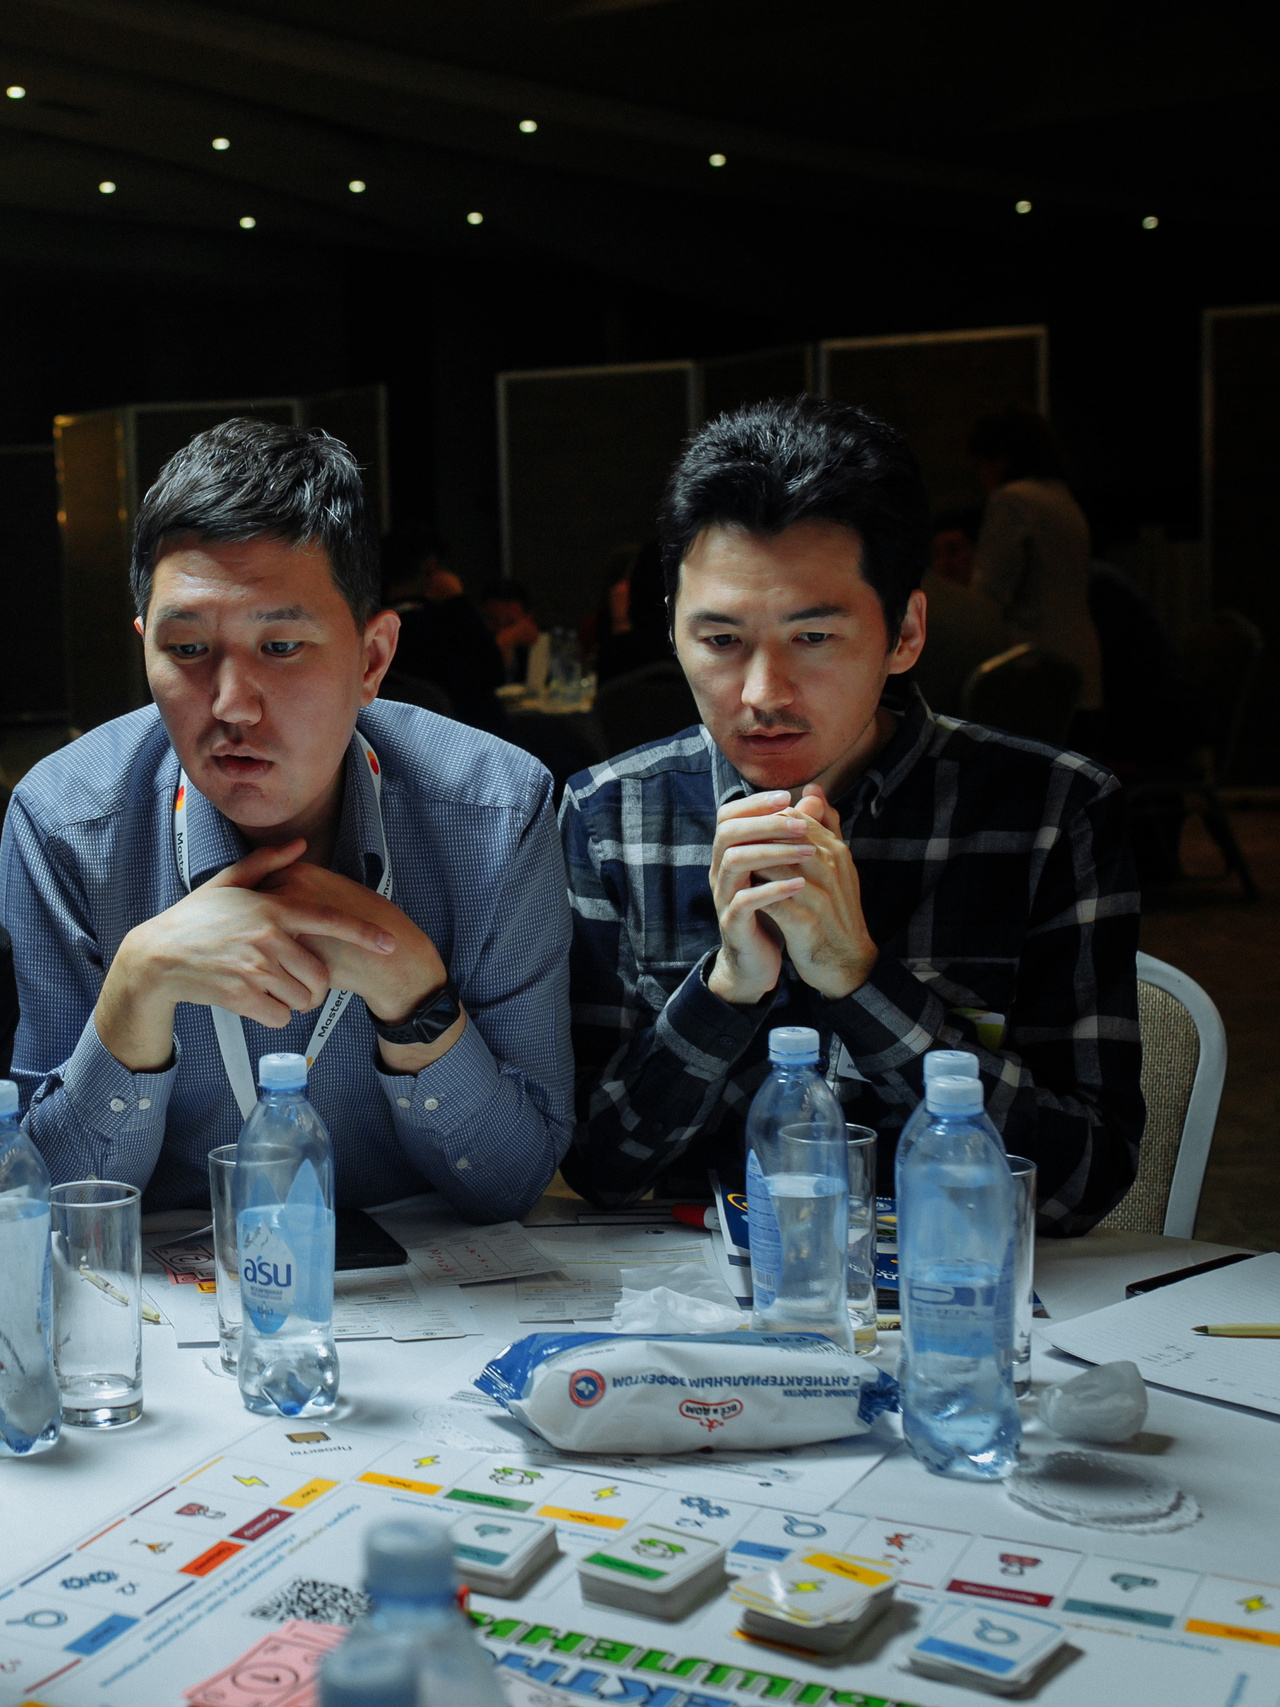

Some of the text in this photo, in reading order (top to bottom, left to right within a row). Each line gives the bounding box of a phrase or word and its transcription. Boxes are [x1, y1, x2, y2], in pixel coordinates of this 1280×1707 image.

[612, 1373, 687, 1389] ЭФФЕКТОМ
[688, 1374, 850, 1389] АНТИБАКТЕРИАЛЬНЫМ
[782, 1388, 823, 1399] салфетки
[685, 1404, 711, 1417] ДОМ
[467, 1610, 925, 1707] ЫШЛЕНИ
